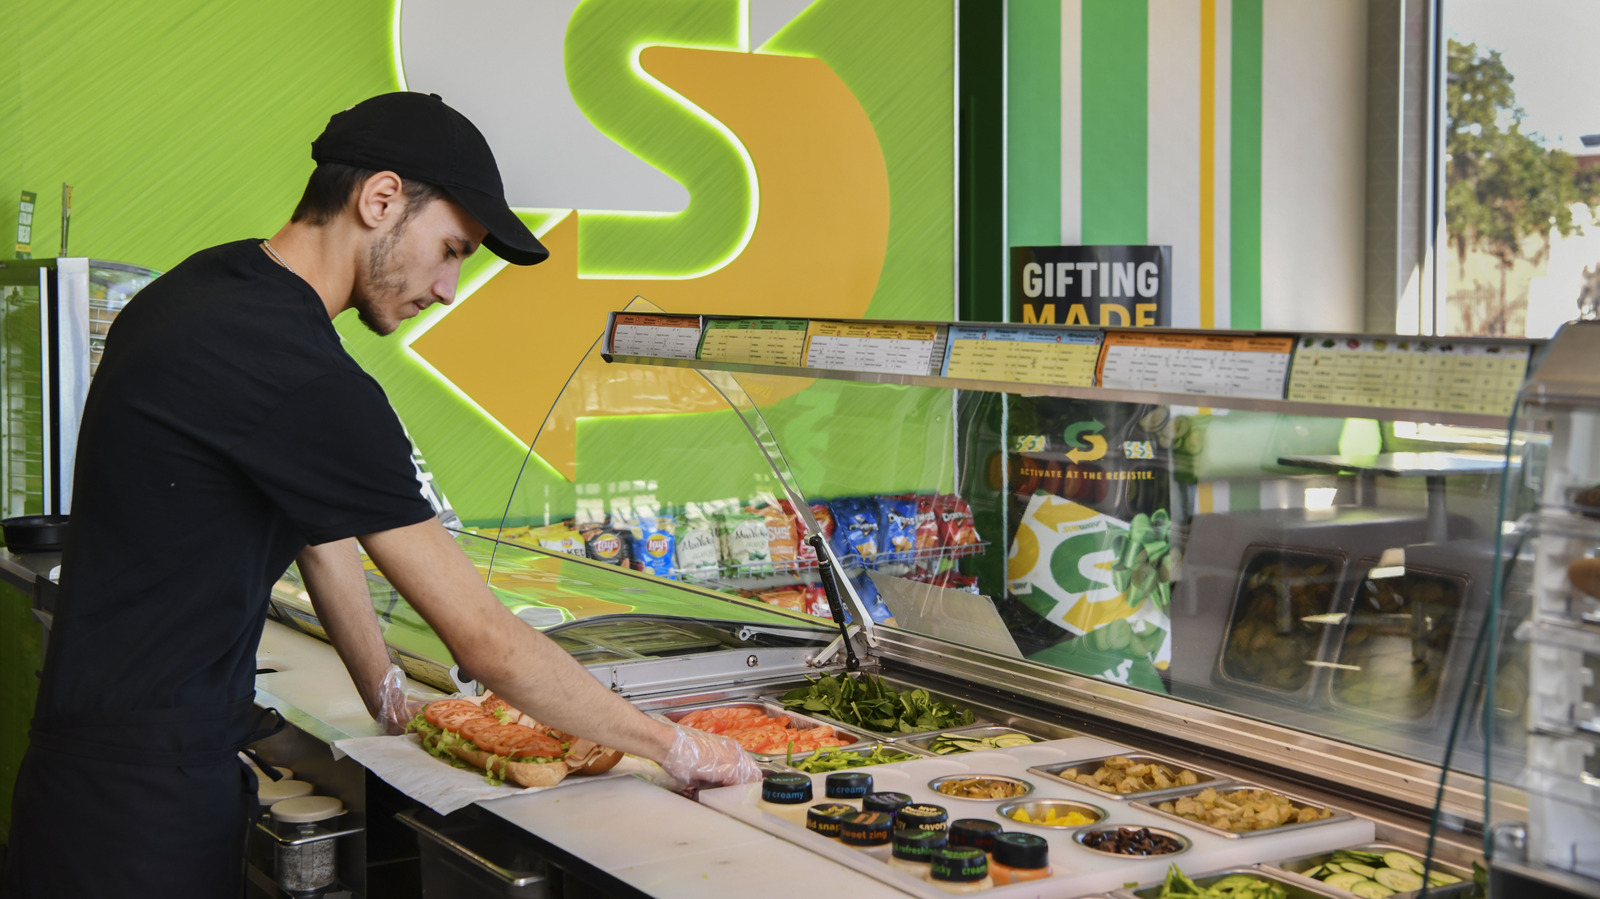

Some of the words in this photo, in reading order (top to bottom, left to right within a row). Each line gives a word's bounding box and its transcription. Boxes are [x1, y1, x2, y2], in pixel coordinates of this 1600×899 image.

[1022, 261, 1159, 298] GIFTING
[1022, 303, 1158, 327] MADE
[1020, 468, 1063, 479] ACTIVATE
[1066, 470, 1079, 479] AT
[1083, 471, 1102, 480] THE
[836, 786, 867, 795] creamy
[772, 791, 804, 801] creamy
[918, 822, 947, 832] savory
[869, 830, 888, 840] zing
